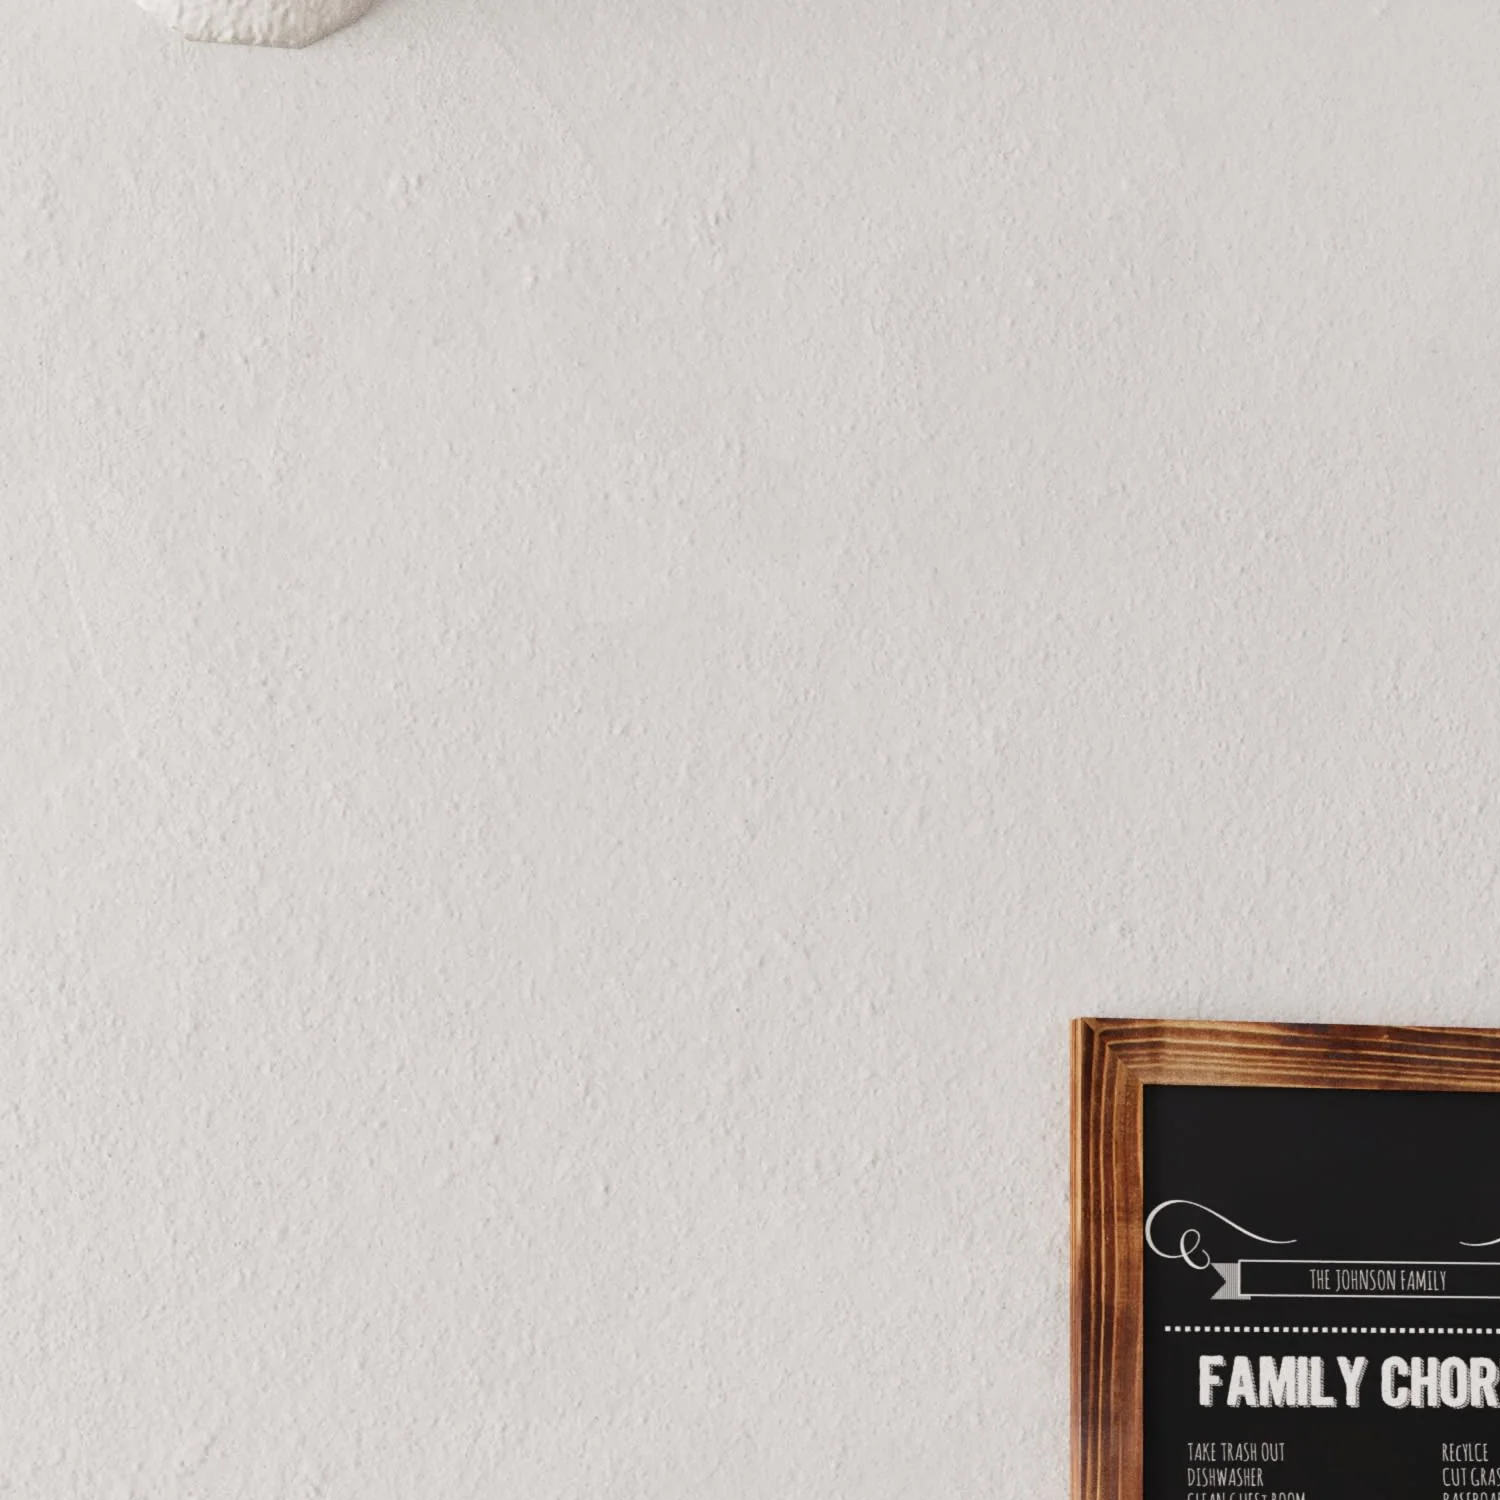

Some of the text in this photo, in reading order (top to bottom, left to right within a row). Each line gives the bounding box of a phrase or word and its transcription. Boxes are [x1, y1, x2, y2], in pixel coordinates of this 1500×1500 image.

[1309, 1268, 1447, 1292] THE JOHNSON FAMILY
[1198, 1354, 1369, 1409] FAMILY
[1187, 1441, 1285, 1462] TAKE TRASH OUT
[1187, 1467, 1264, 1488] DISHWASHER
[1442, 1467, 1467, 1487] CUT
